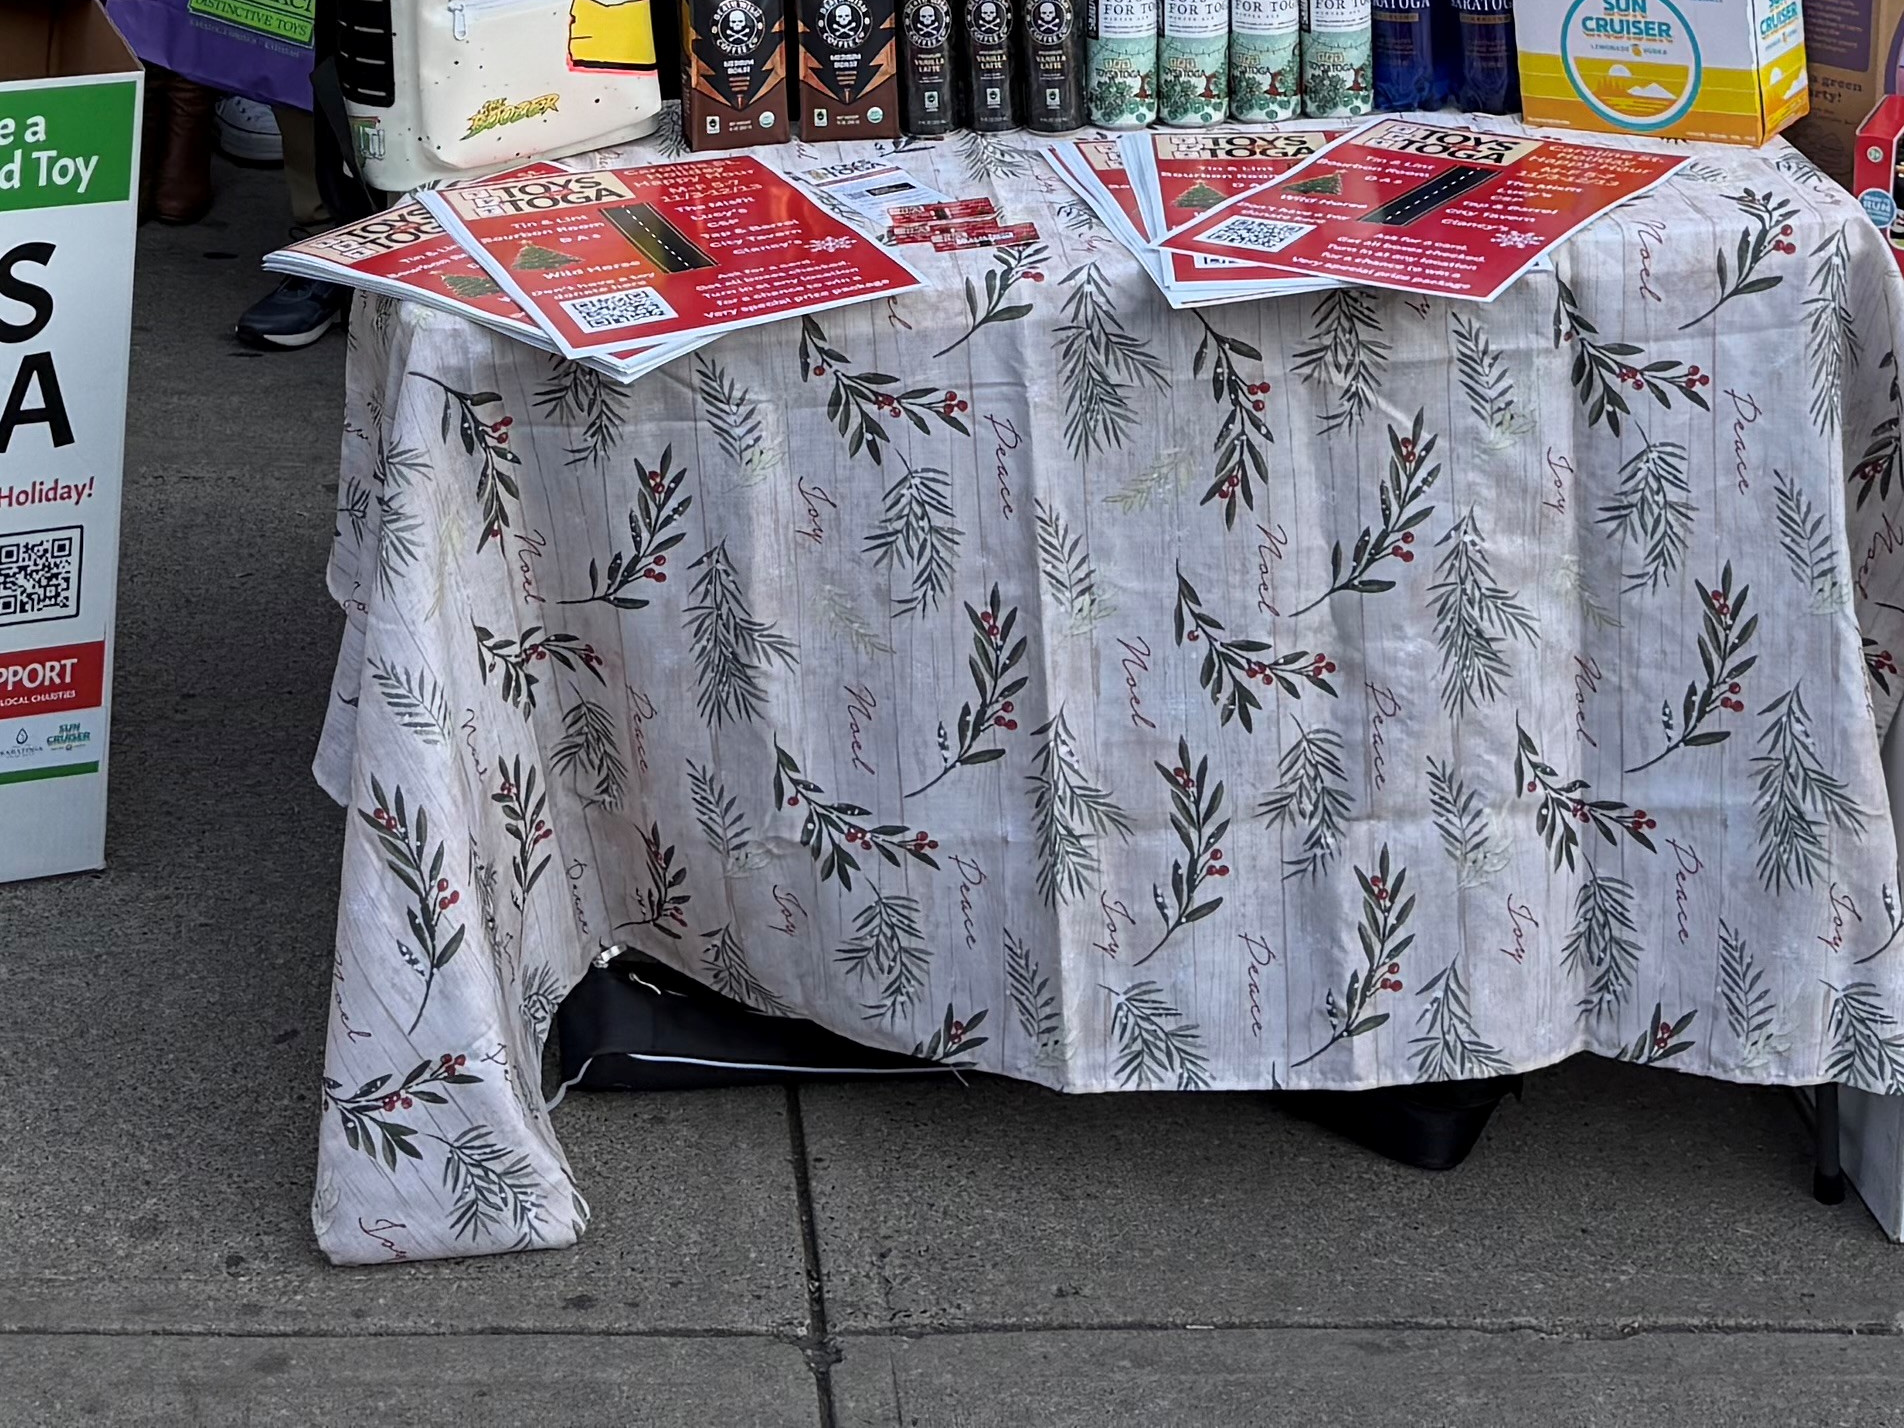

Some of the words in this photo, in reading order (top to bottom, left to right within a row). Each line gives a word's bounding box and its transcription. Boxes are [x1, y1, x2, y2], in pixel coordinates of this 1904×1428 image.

[1581, 15, 1674, 39] CRUISER
[24, 115, 46, 143] a
[31, 150, 99, 193] Toy
